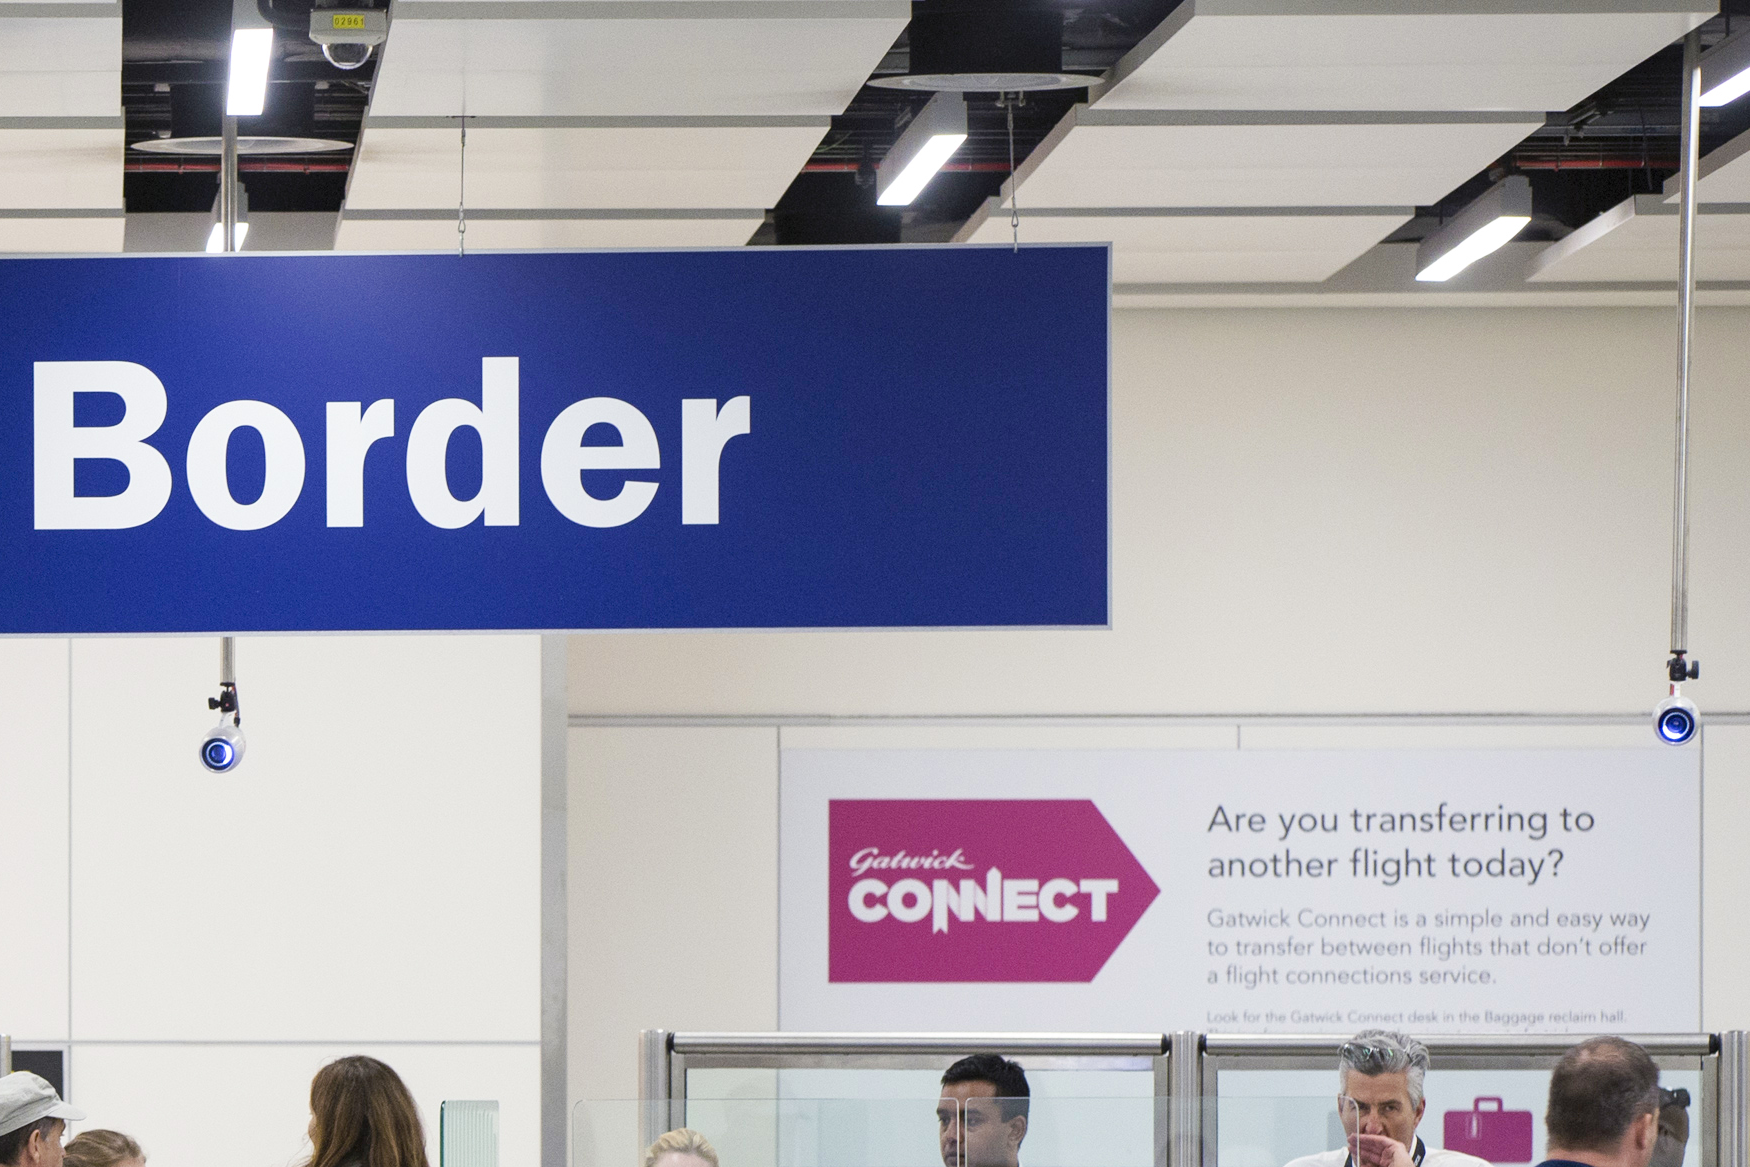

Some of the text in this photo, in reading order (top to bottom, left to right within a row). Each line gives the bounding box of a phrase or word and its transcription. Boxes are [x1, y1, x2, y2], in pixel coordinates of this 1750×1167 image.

[334, 17, 364, 26] 02961
[32, 354, 752, 534] Border
[1207, 801, 1596, 842] Are you transferring to
[849, 847, 975, 877] Gatwick
[1207, 847, 1565, 887] another flight today?
[848, 866, 1119, 934] CONNECT
[1207, 907, 1651, 933] Gatwick Connect is a simple and easy way
[1207, 940, 1229, 956] to
[1235, 936, 1314, 956] transfer
[1320, 937, 1412, 956] between
[1419, 936, 1483, 961] flights
[1489, 937, 1530, 956] that
[1598, 935, 1648, 956] offer
[1207, 964, 1497, 990] a flight connections service.
[1206, 1009, 1628, 1026] Look for the Gatwick Connect desk in the Baggage reclaim hall.
